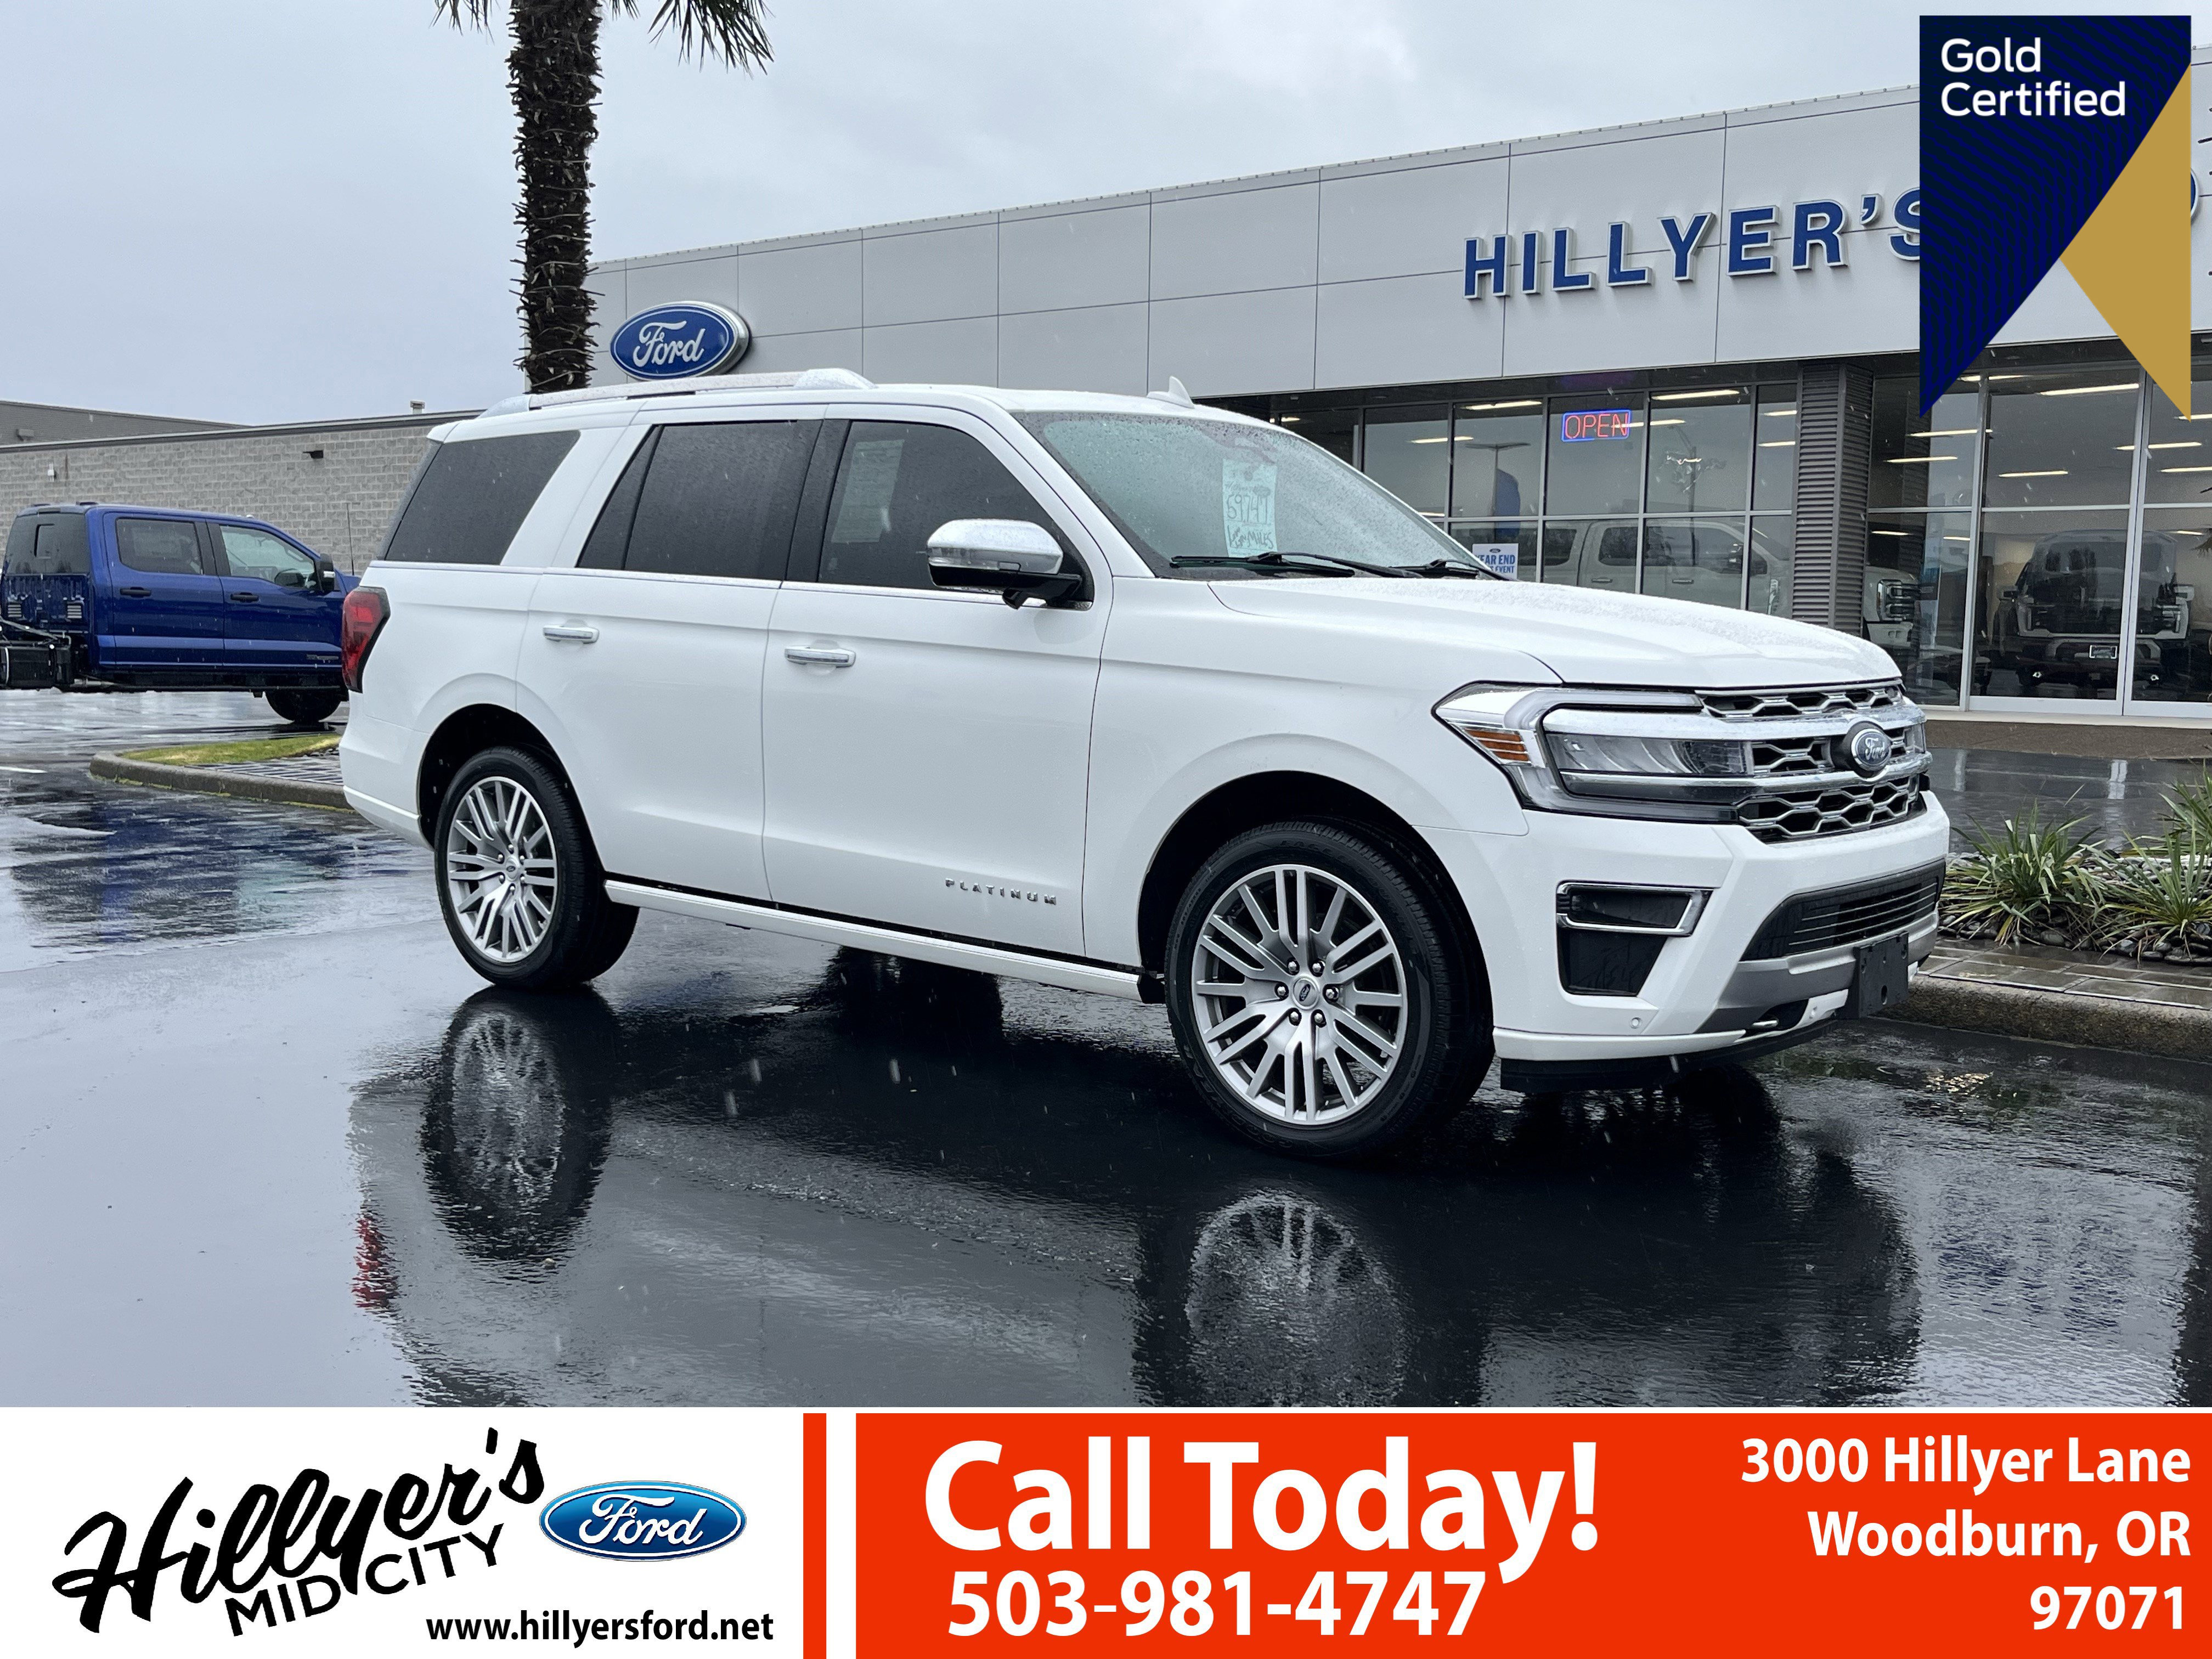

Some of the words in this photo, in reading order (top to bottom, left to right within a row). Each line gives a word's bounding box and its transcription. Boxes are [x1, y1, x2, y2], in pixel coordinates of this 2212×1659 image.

[633, 320, 706, 368] Ford
[1564, 413, 1629, 439] OPEN
[1475, 555, 1497, 565] EAR
[1498, 555, 1516, 565] END
[1865, 737, 1886, 761] Ford
[945, 877, 1057, 905] PLATINUM
